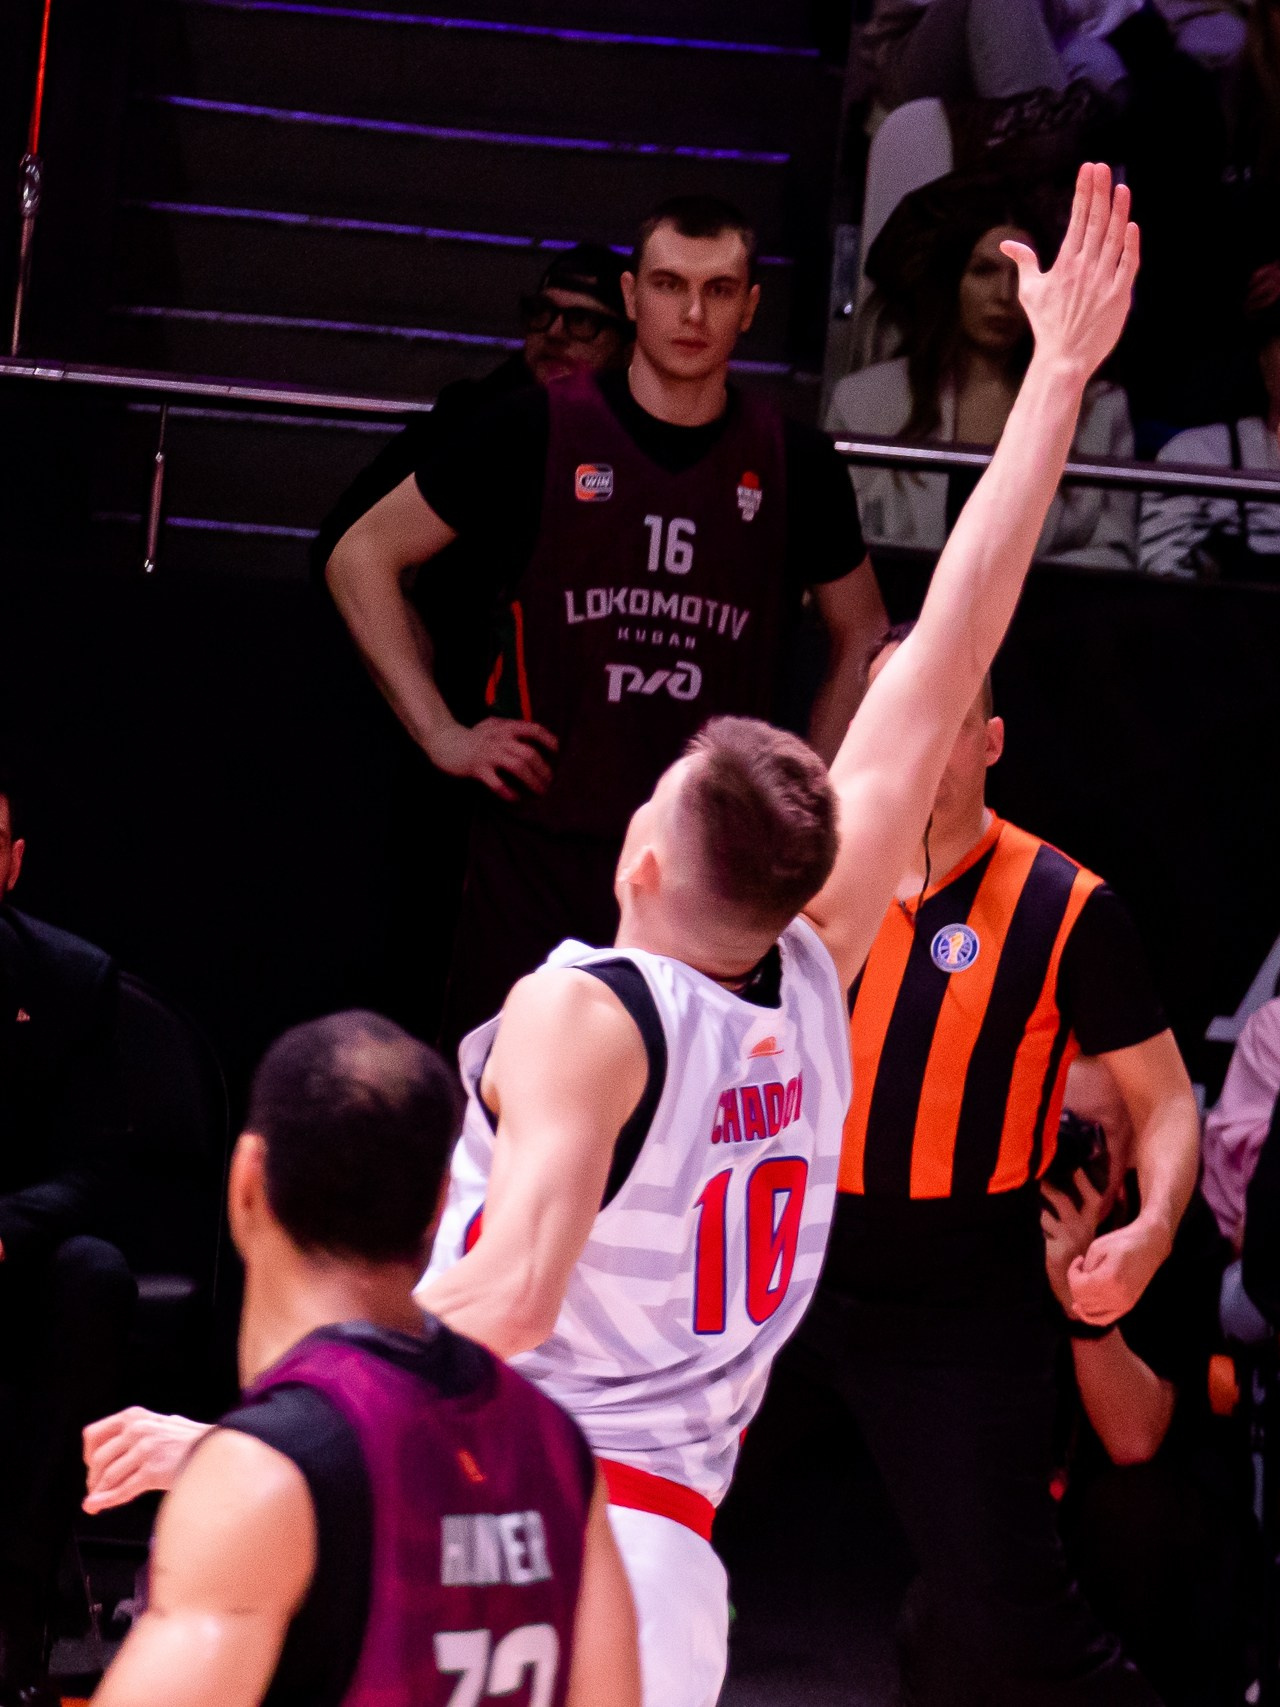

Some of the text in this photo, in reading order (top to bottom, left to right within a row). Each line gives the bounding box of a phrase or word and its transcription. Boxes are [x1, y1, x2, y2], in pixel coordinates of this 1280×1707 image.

[644, 514, 697, 574] 16
[564, 587, 750, 641] LOKOMOTIV
[711, 1070, 803, 1144] CHADO
[692, 1155, 809, 1335] 10
